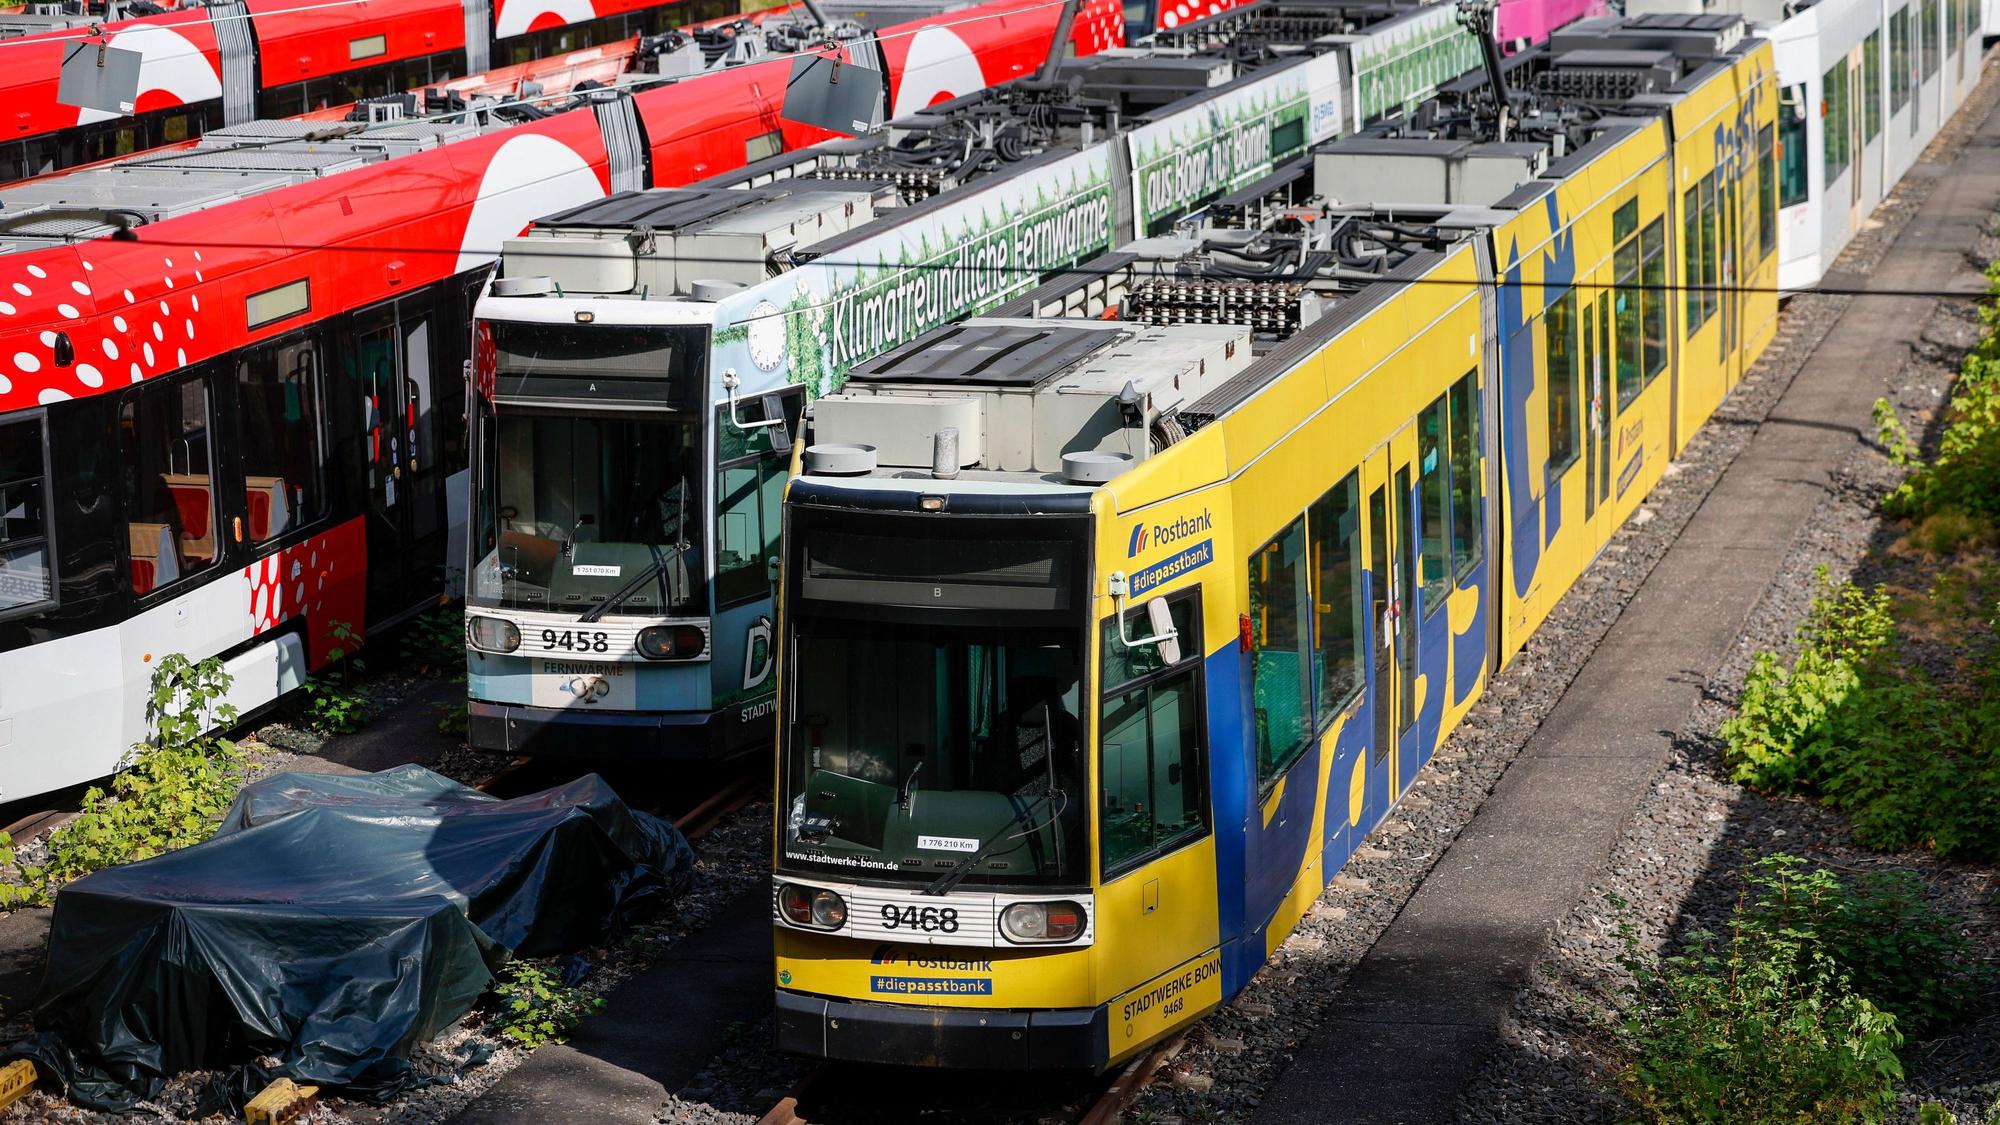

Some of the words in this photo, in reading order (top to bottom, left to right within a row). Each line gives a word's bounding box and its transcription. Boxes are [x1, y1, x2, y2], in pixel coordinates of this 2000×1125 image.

[1148, 166, 1172, 215] aus
[1233, 108, 1271, 175] Bonn!
[832, 228, 1008, 367] Klimafreundliche
[1013, 194, 1109, 281] Fernwärme
[589, 383, 596, 391] A
[1153, 507, 1212, 547] Postbank
[1134, 543, 1209, 592] #diepasstbank
[934, 587, 942, 597] B
[541, 629, 609, 653] 9458
[544, 661, 624, 677] FERNWÄRME
[959, 841, 973, 849] Km
[785, 851, 899, 871] www.stadtwerke-bonn.de
[880, 904, 960, 934] 9468
[907, 951, 993, 972] Postbank
[876, 977, 986, 994] #diepasstbank
[1123, 972, 1192, 1021] STADTWERKE
[1194, 958, 1222, 983] BONN
[1163, 997, 1184, 1019] 9468
